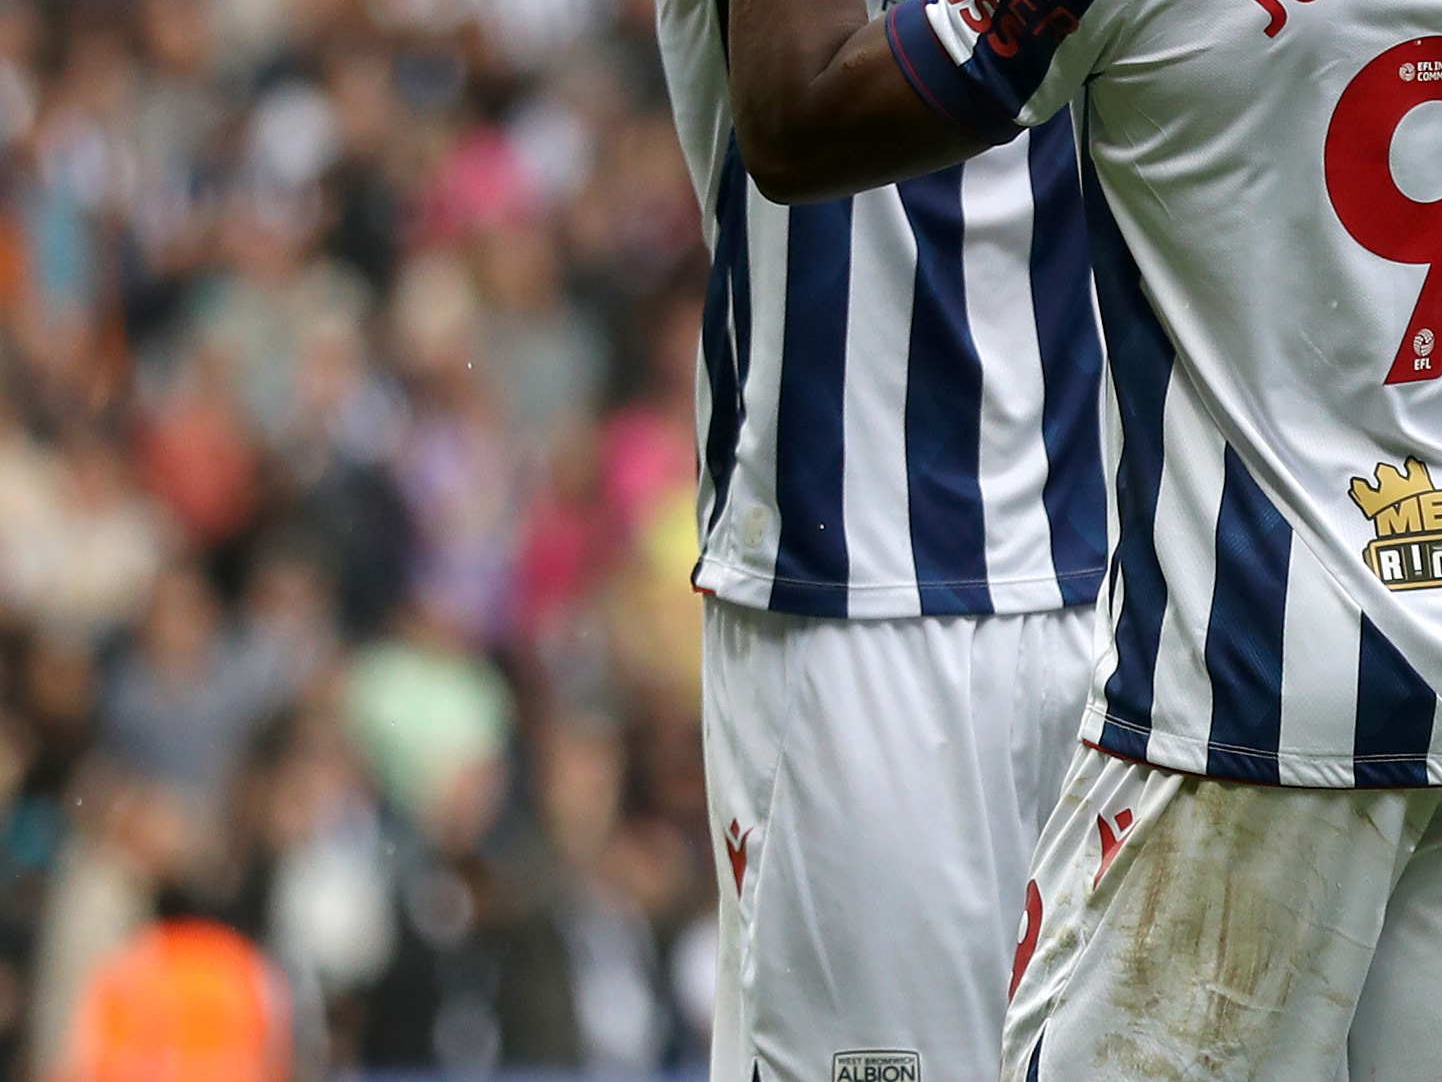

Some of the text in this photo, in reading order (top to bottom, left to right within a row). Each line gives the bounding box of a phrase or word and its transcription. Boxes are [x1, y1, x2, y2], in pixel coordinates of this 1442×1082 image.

[1417, 61, 1433, 72] EFL
[1413, 358, 1432, 371] EFL
[838, 1065, 915, 1082] ALBION
